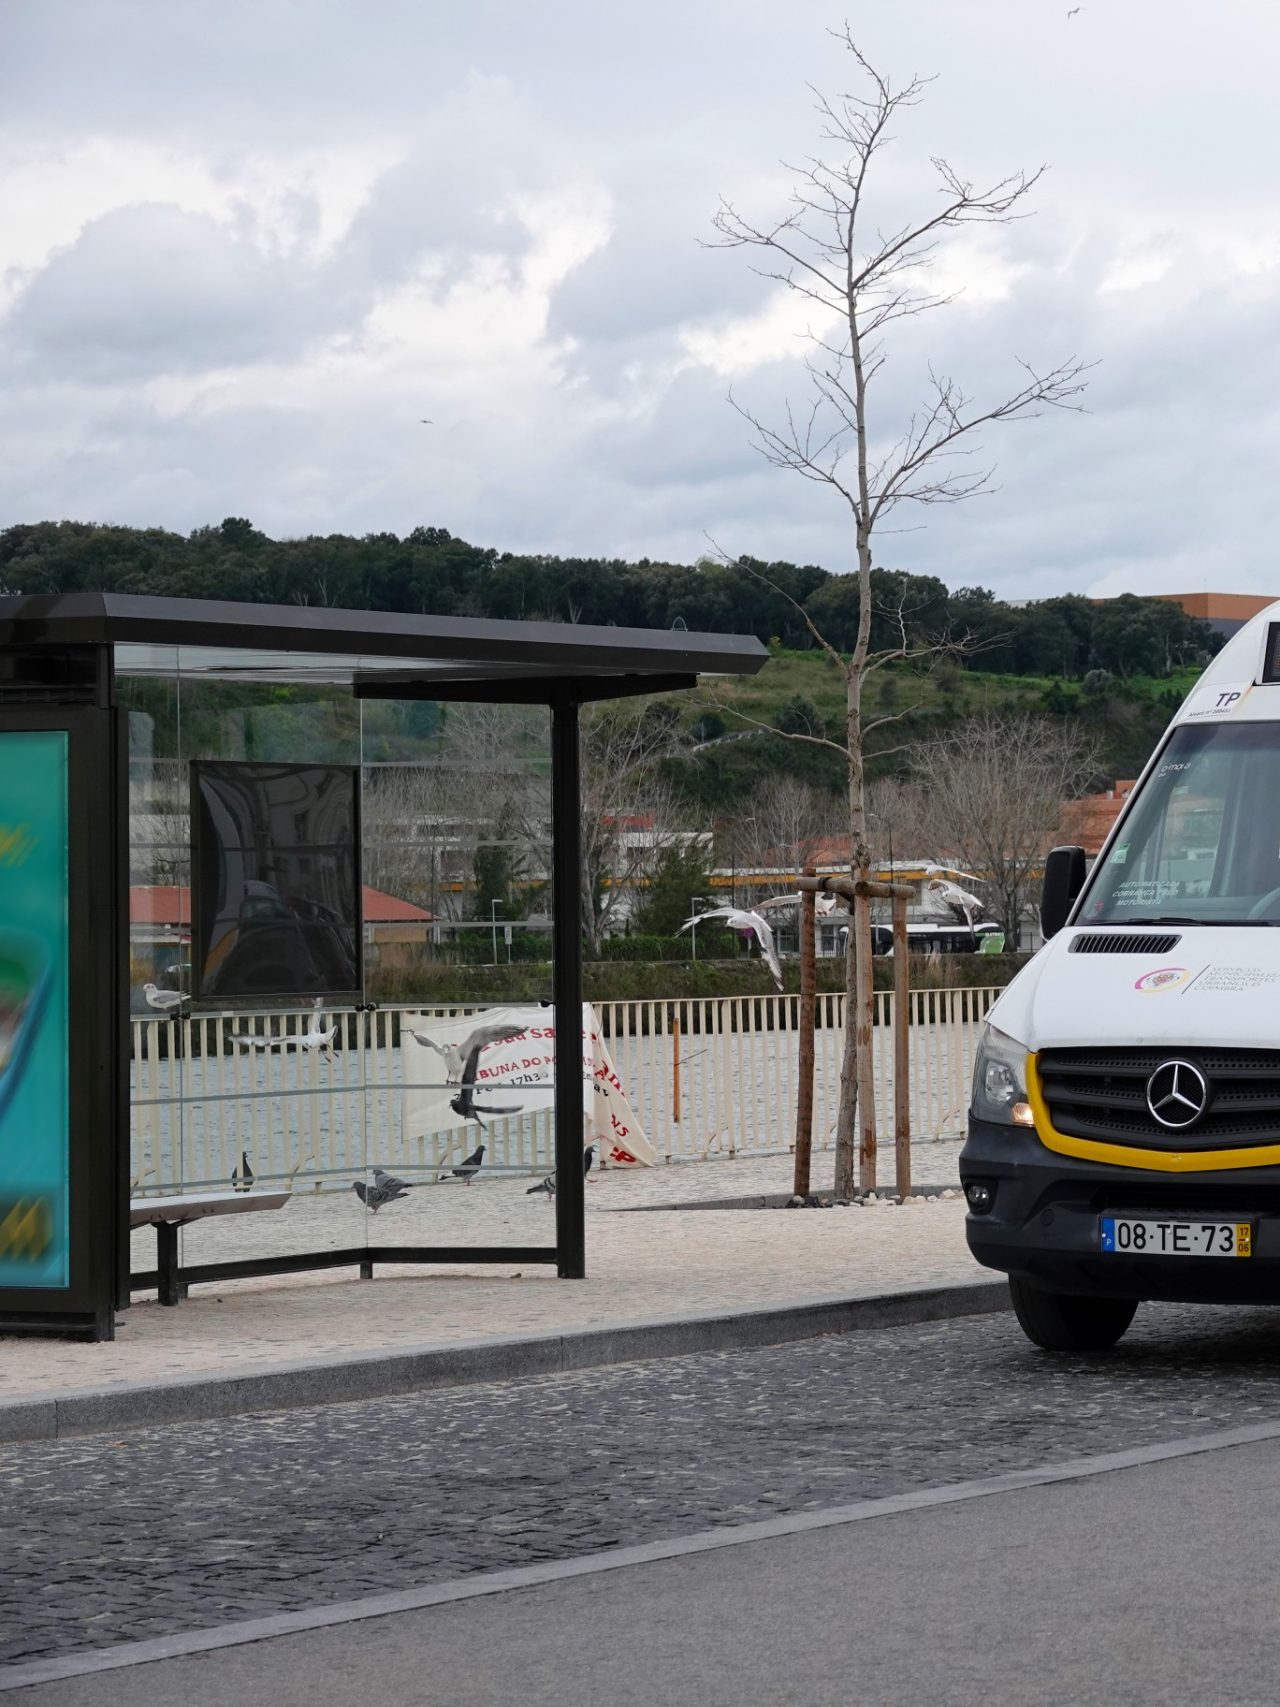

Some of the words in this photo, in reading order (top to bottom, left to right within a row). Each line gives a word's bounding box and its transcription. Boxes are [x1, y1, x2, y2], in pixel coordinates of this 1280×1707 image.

[1215, 692, 1242, 708] TP
[522, 1056, 542, 1069] DO
[1240, 1227, 1249, 1236] 17
[1106, 1239, 1113, 1247] P
[1238, 1243, 1249, 1252] 06
